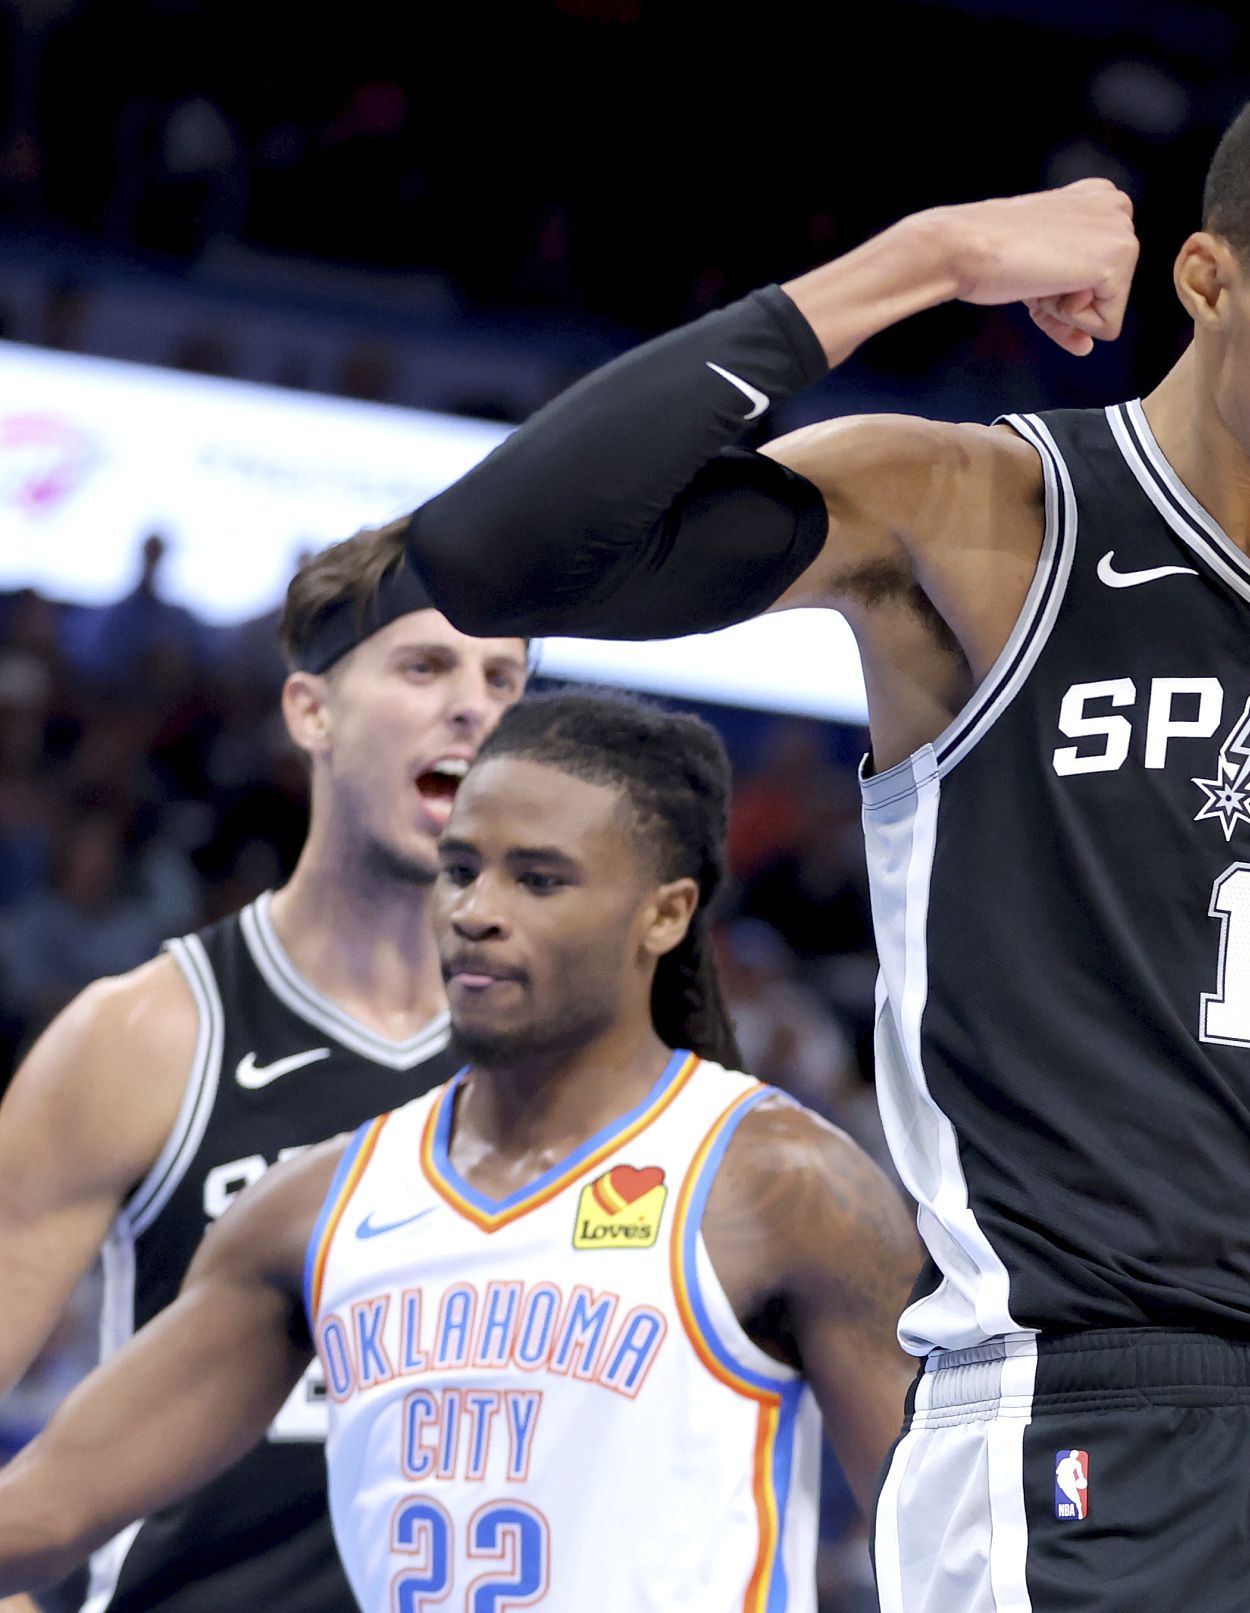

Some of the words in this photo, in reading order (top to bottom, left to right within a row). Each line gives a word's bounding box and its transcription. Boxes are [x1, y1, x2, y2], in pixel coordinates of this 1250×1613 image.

[315, 1279, 668, 1401] OKLAHOMA
[402, 1387, 543, 1483] CITY
[390, 1493, 551, 1613] 22
[1058, 1503, 1076, 1517] NBA
